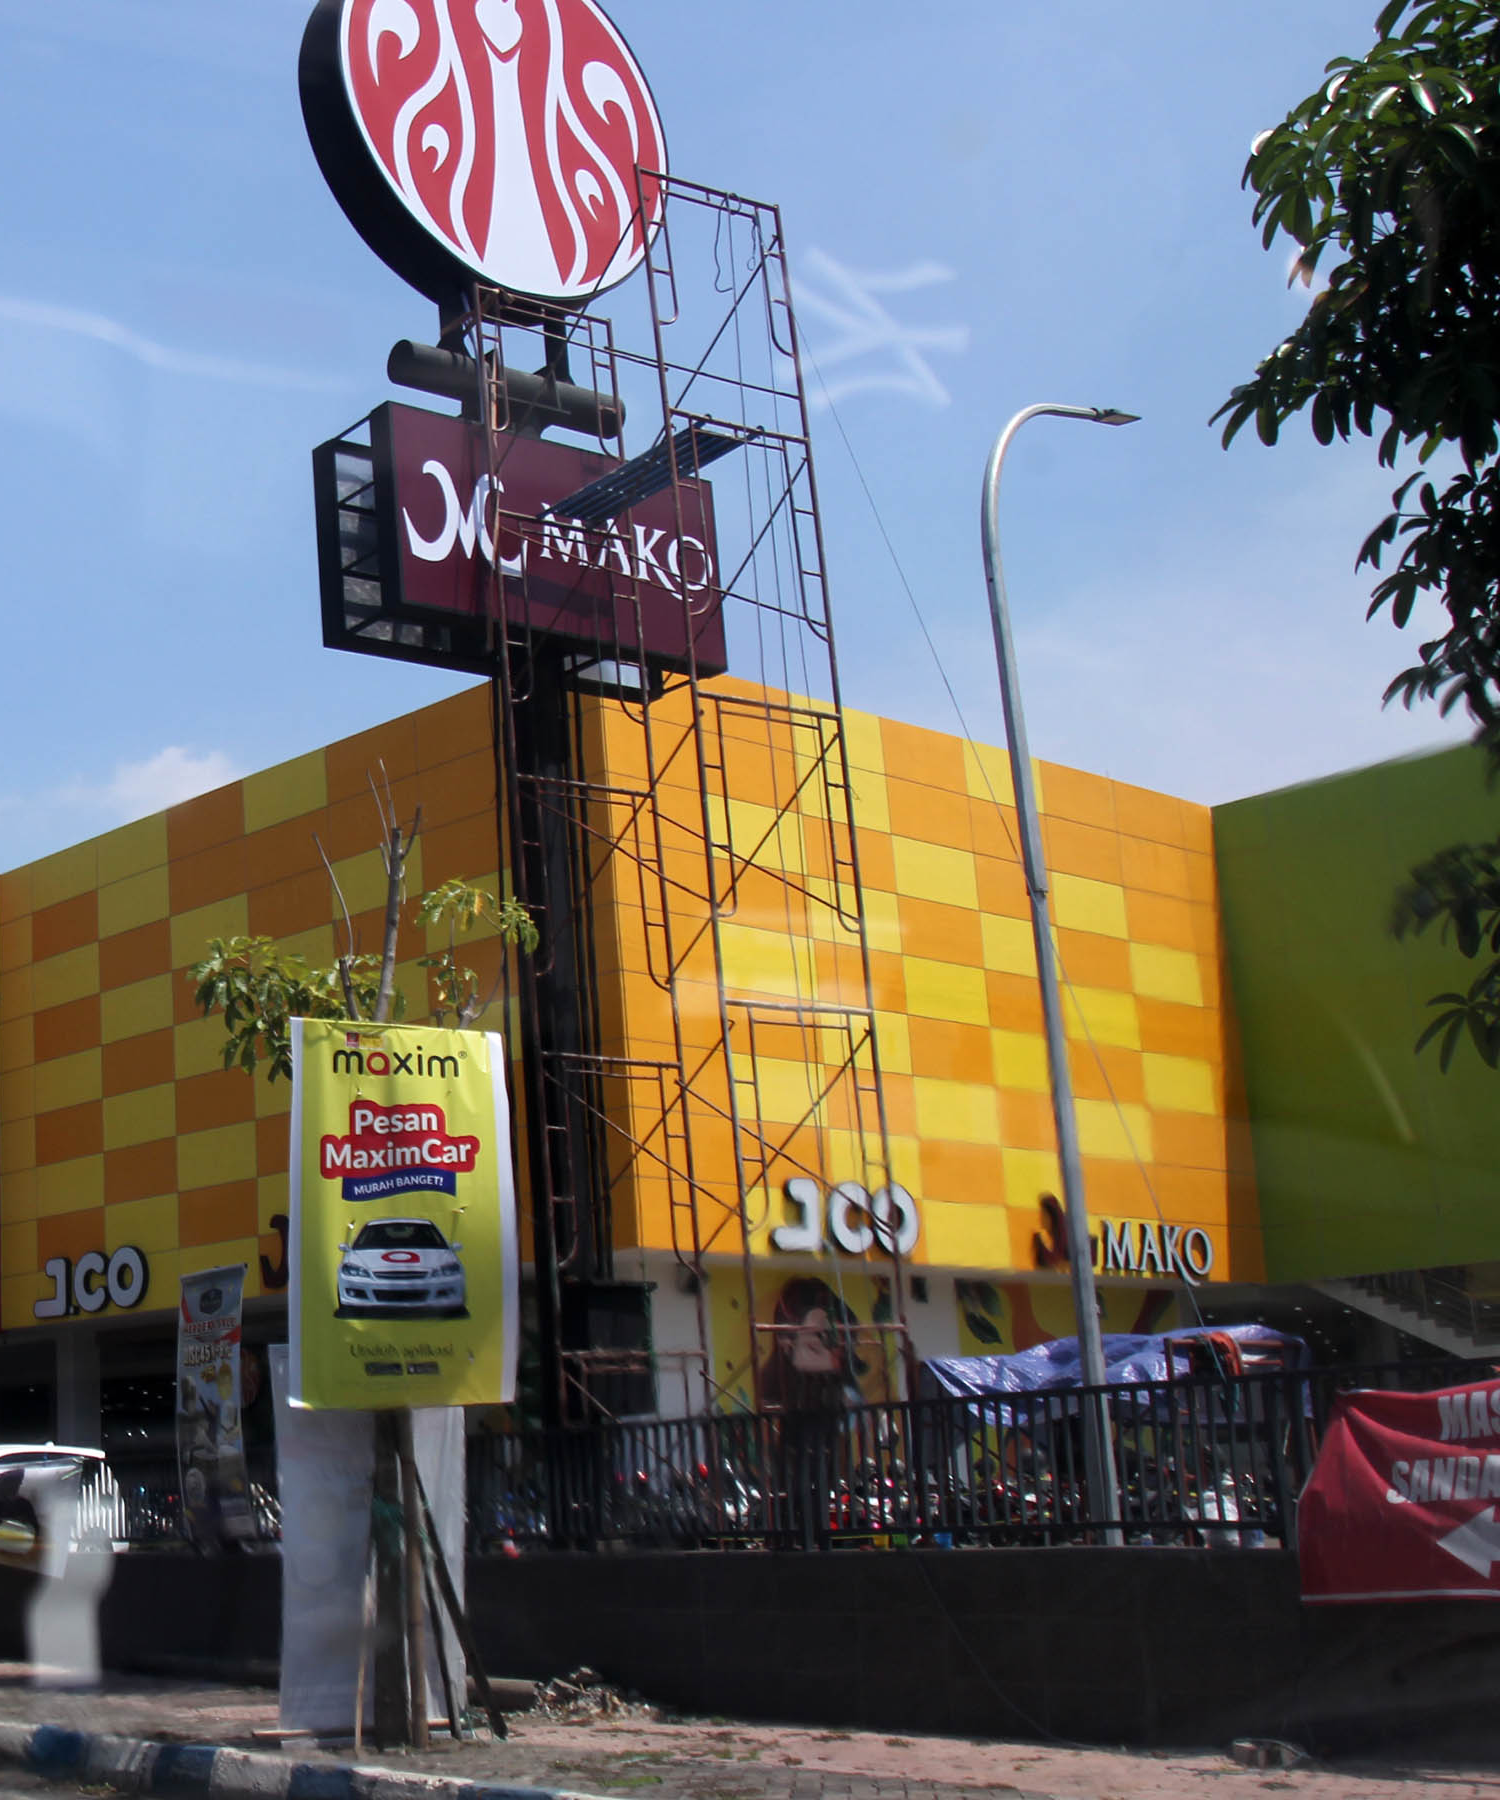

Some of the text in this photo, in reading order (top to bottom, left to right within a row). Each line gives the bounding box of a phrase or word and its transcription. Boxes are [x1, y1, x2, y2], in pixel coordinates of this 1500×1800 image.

[540, 502, 713, 602] MAKO
[355, 1109, 438, 1135] Pesan
[325, 1139, 472, 1169] MaximCar
[354, 1174, 444, 1195] MURAH BANGET!
[1104, 1220, 1213, 1286] MAKO
